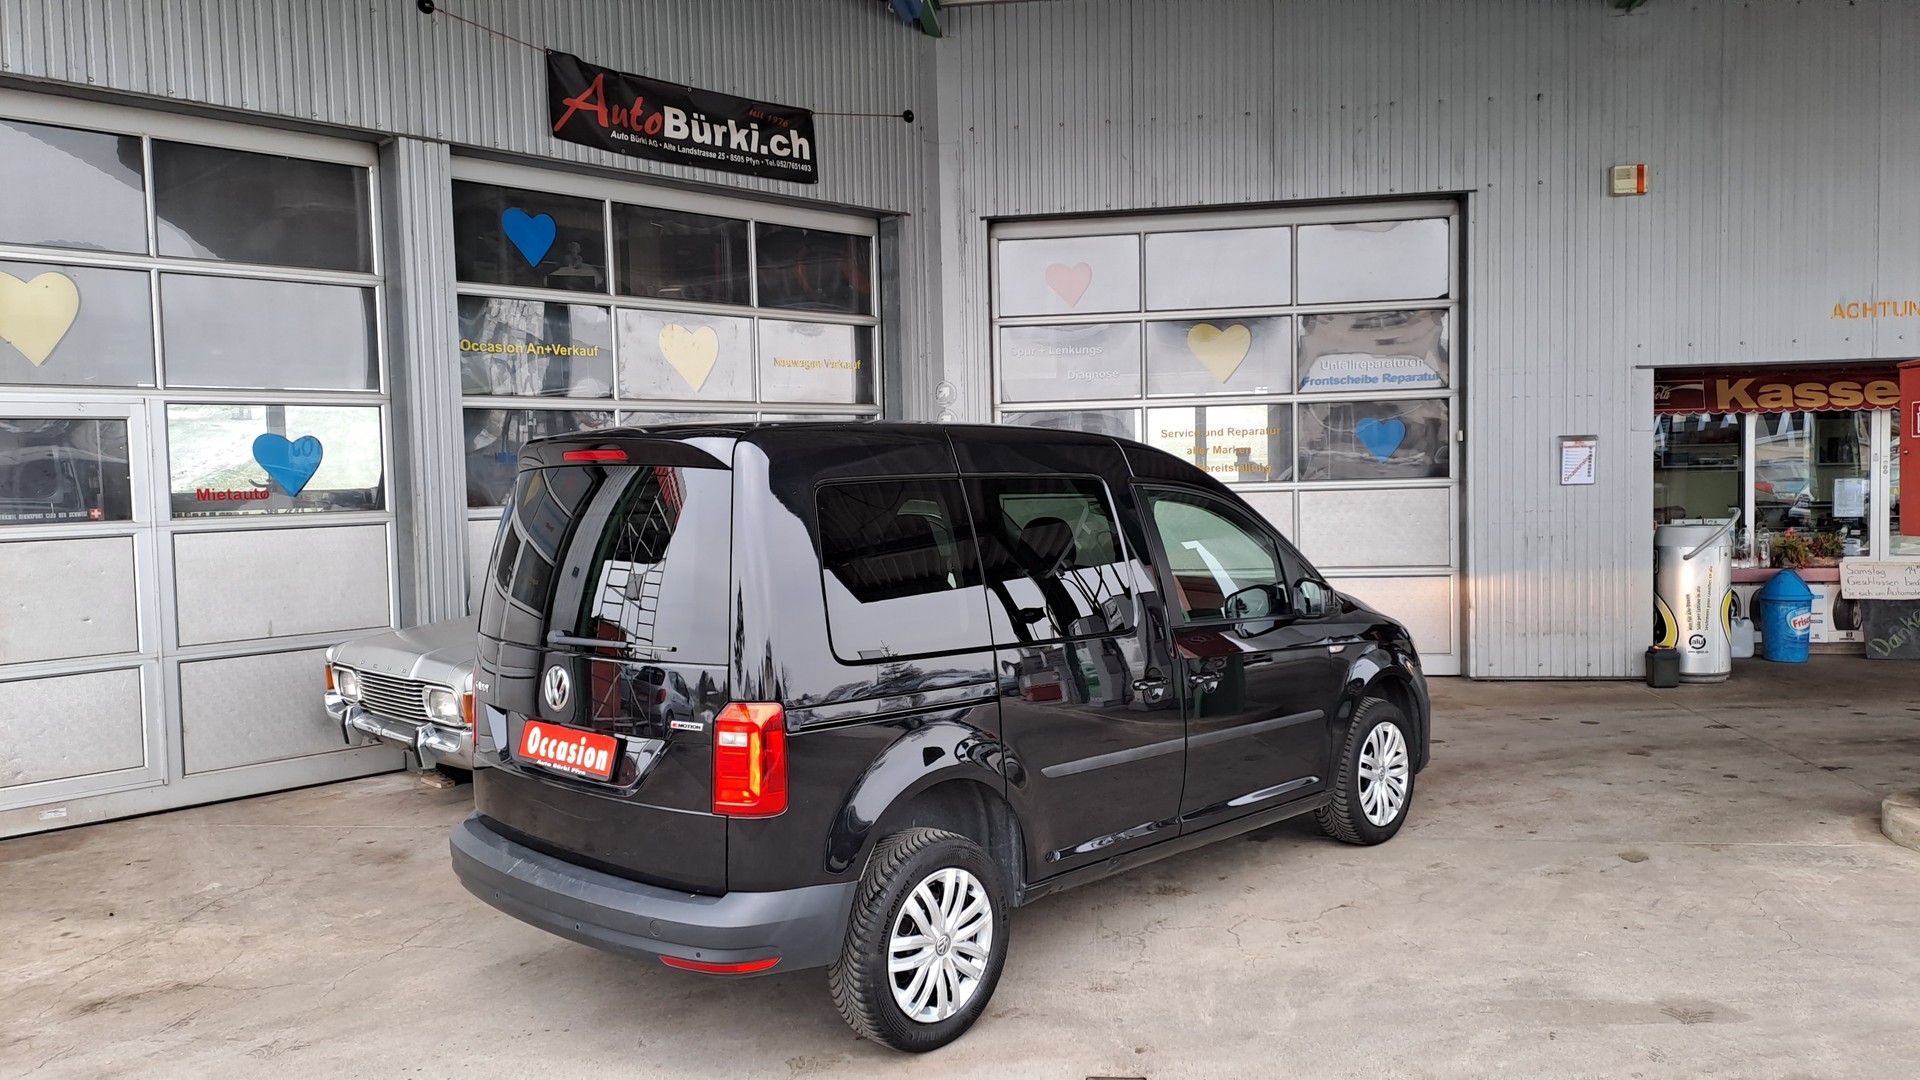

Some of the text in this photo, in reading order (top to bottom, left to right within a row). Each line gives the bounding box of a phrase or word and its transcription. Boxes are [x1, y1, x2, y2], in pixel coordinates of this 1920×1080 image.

[767, 114, 789, 128] 1976
[610, 130, 629, 141] Auto
[630, 134, 648, 145] Bürki
[648, 139, 658, 148] AG
[663, 142, 676, 152] Alte
[677, 144, 717, 159] Landstrasse
[717, 151, 726, 160] 25
[730, 154, 745, 163] 8505
[460, 339, 599, 357] Occasion An+Verkauf
[1011, 347, 1036, 358] Spur
[1049, 345, 1103, 356] Lenkungs
[823, 358, 863, 370] Verkauf
[1321, 359, 1424, 371] Unfallreparaturen
[1067, 369, 1119, 381] Diagnose
[1302, 371, 1440, 386] Frontscheibe Reparatur
[1716, 378, 1900, 409] Kasse
[1161, 427, 1281, 438] Service und Reparatur
[1187, 445, 1251, 455] aller Marken
[196, 488, 270, 501] Mietauto
[1846, 564, 1886, 578] Samstag
[1847, 576, 1899, 586] Geschlossen
[527, 726, 608, 771] Occasion
[536, 759, 552, 767] Auto
[552, 761, 571, 772] Bürki
